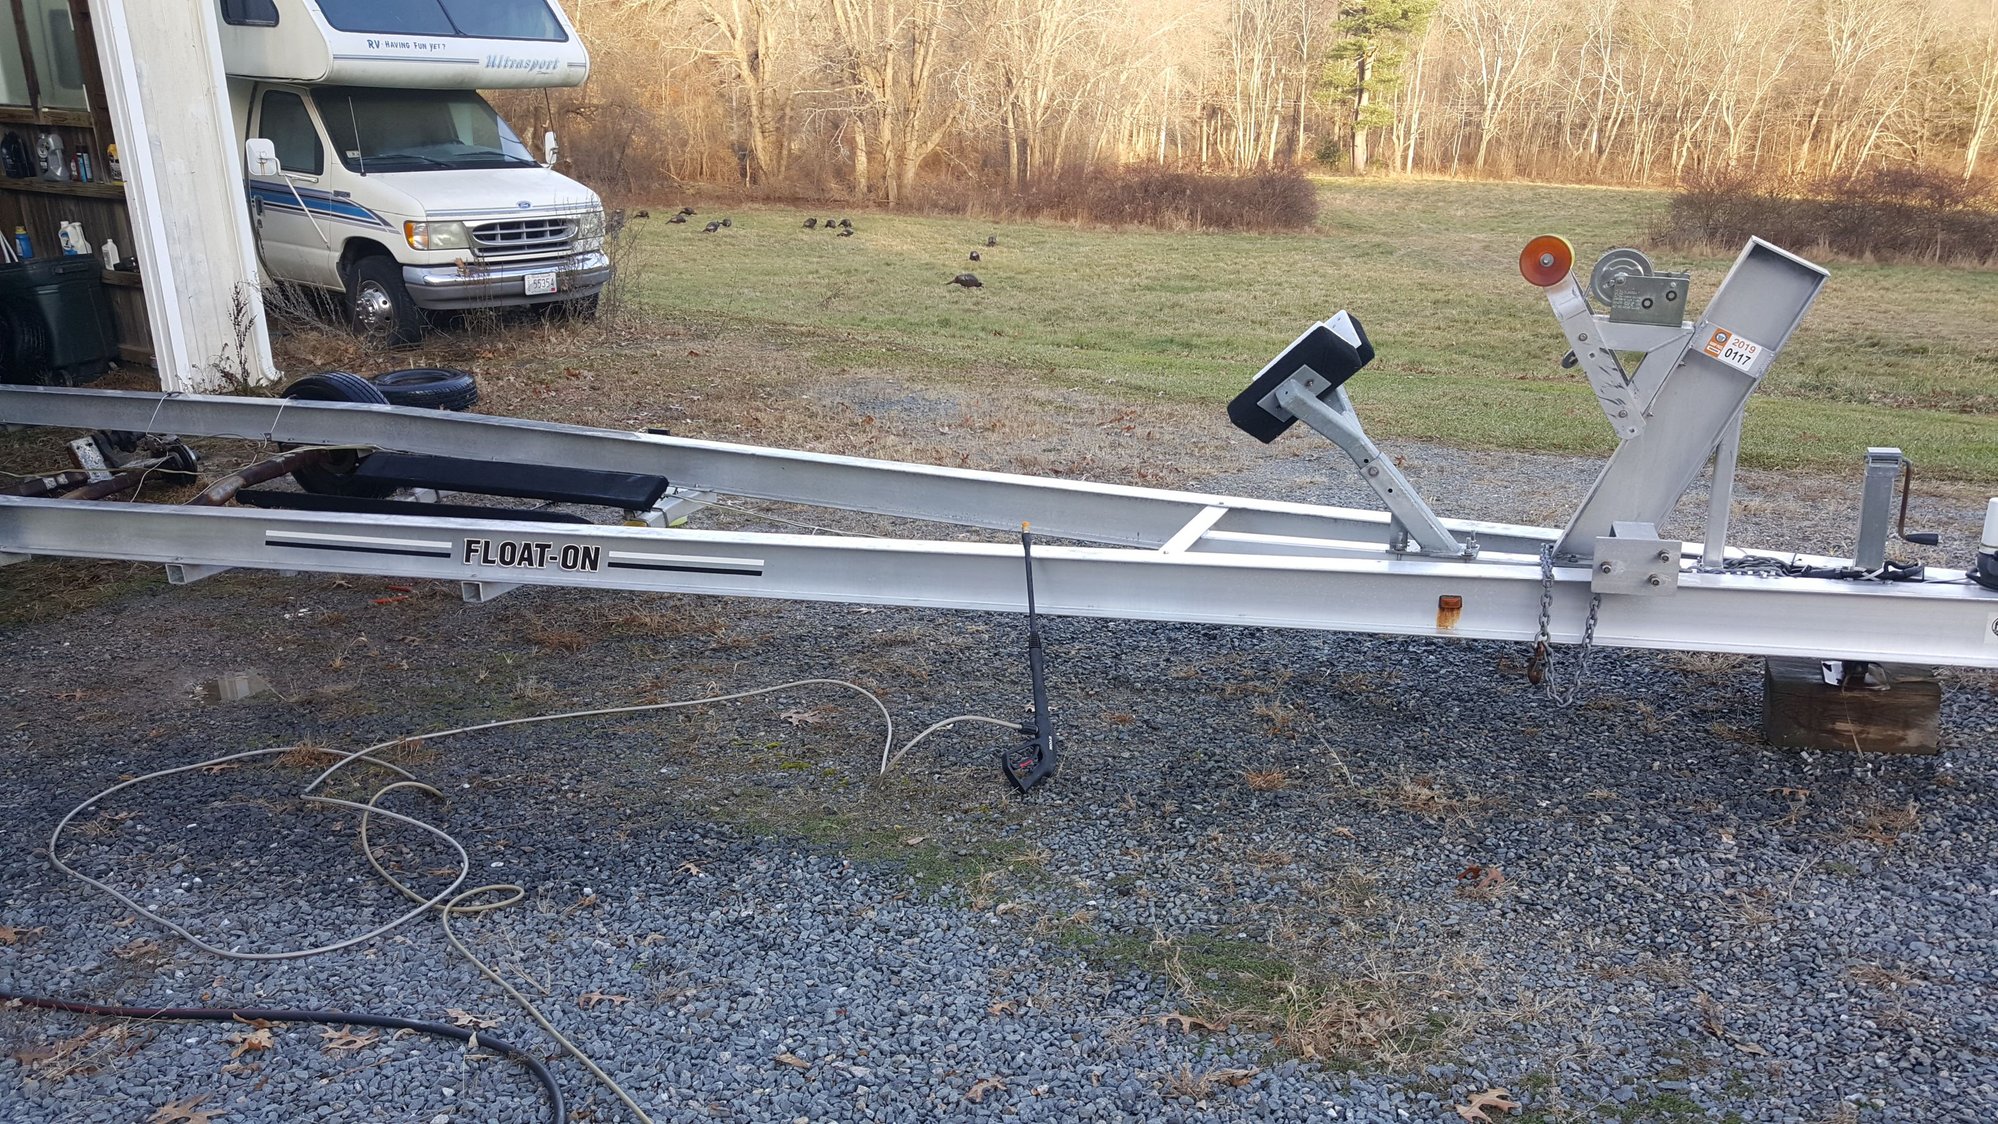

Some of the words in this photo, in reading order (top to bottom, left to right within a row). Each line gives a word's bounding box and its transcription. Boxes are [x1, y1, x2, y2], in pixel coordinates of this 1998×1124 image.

[366, 39, 380, 49] RV
[385, 40, 410, 49] HAVING
[413, 41, 427, 50] FUN
[485, 54, 560, 73] Ultrasport
[1732, 338, 1757, 354] 2019
[1724, 347, 1751, 365] 0117
[463, 538, 601, 573] FLOAT-ON
